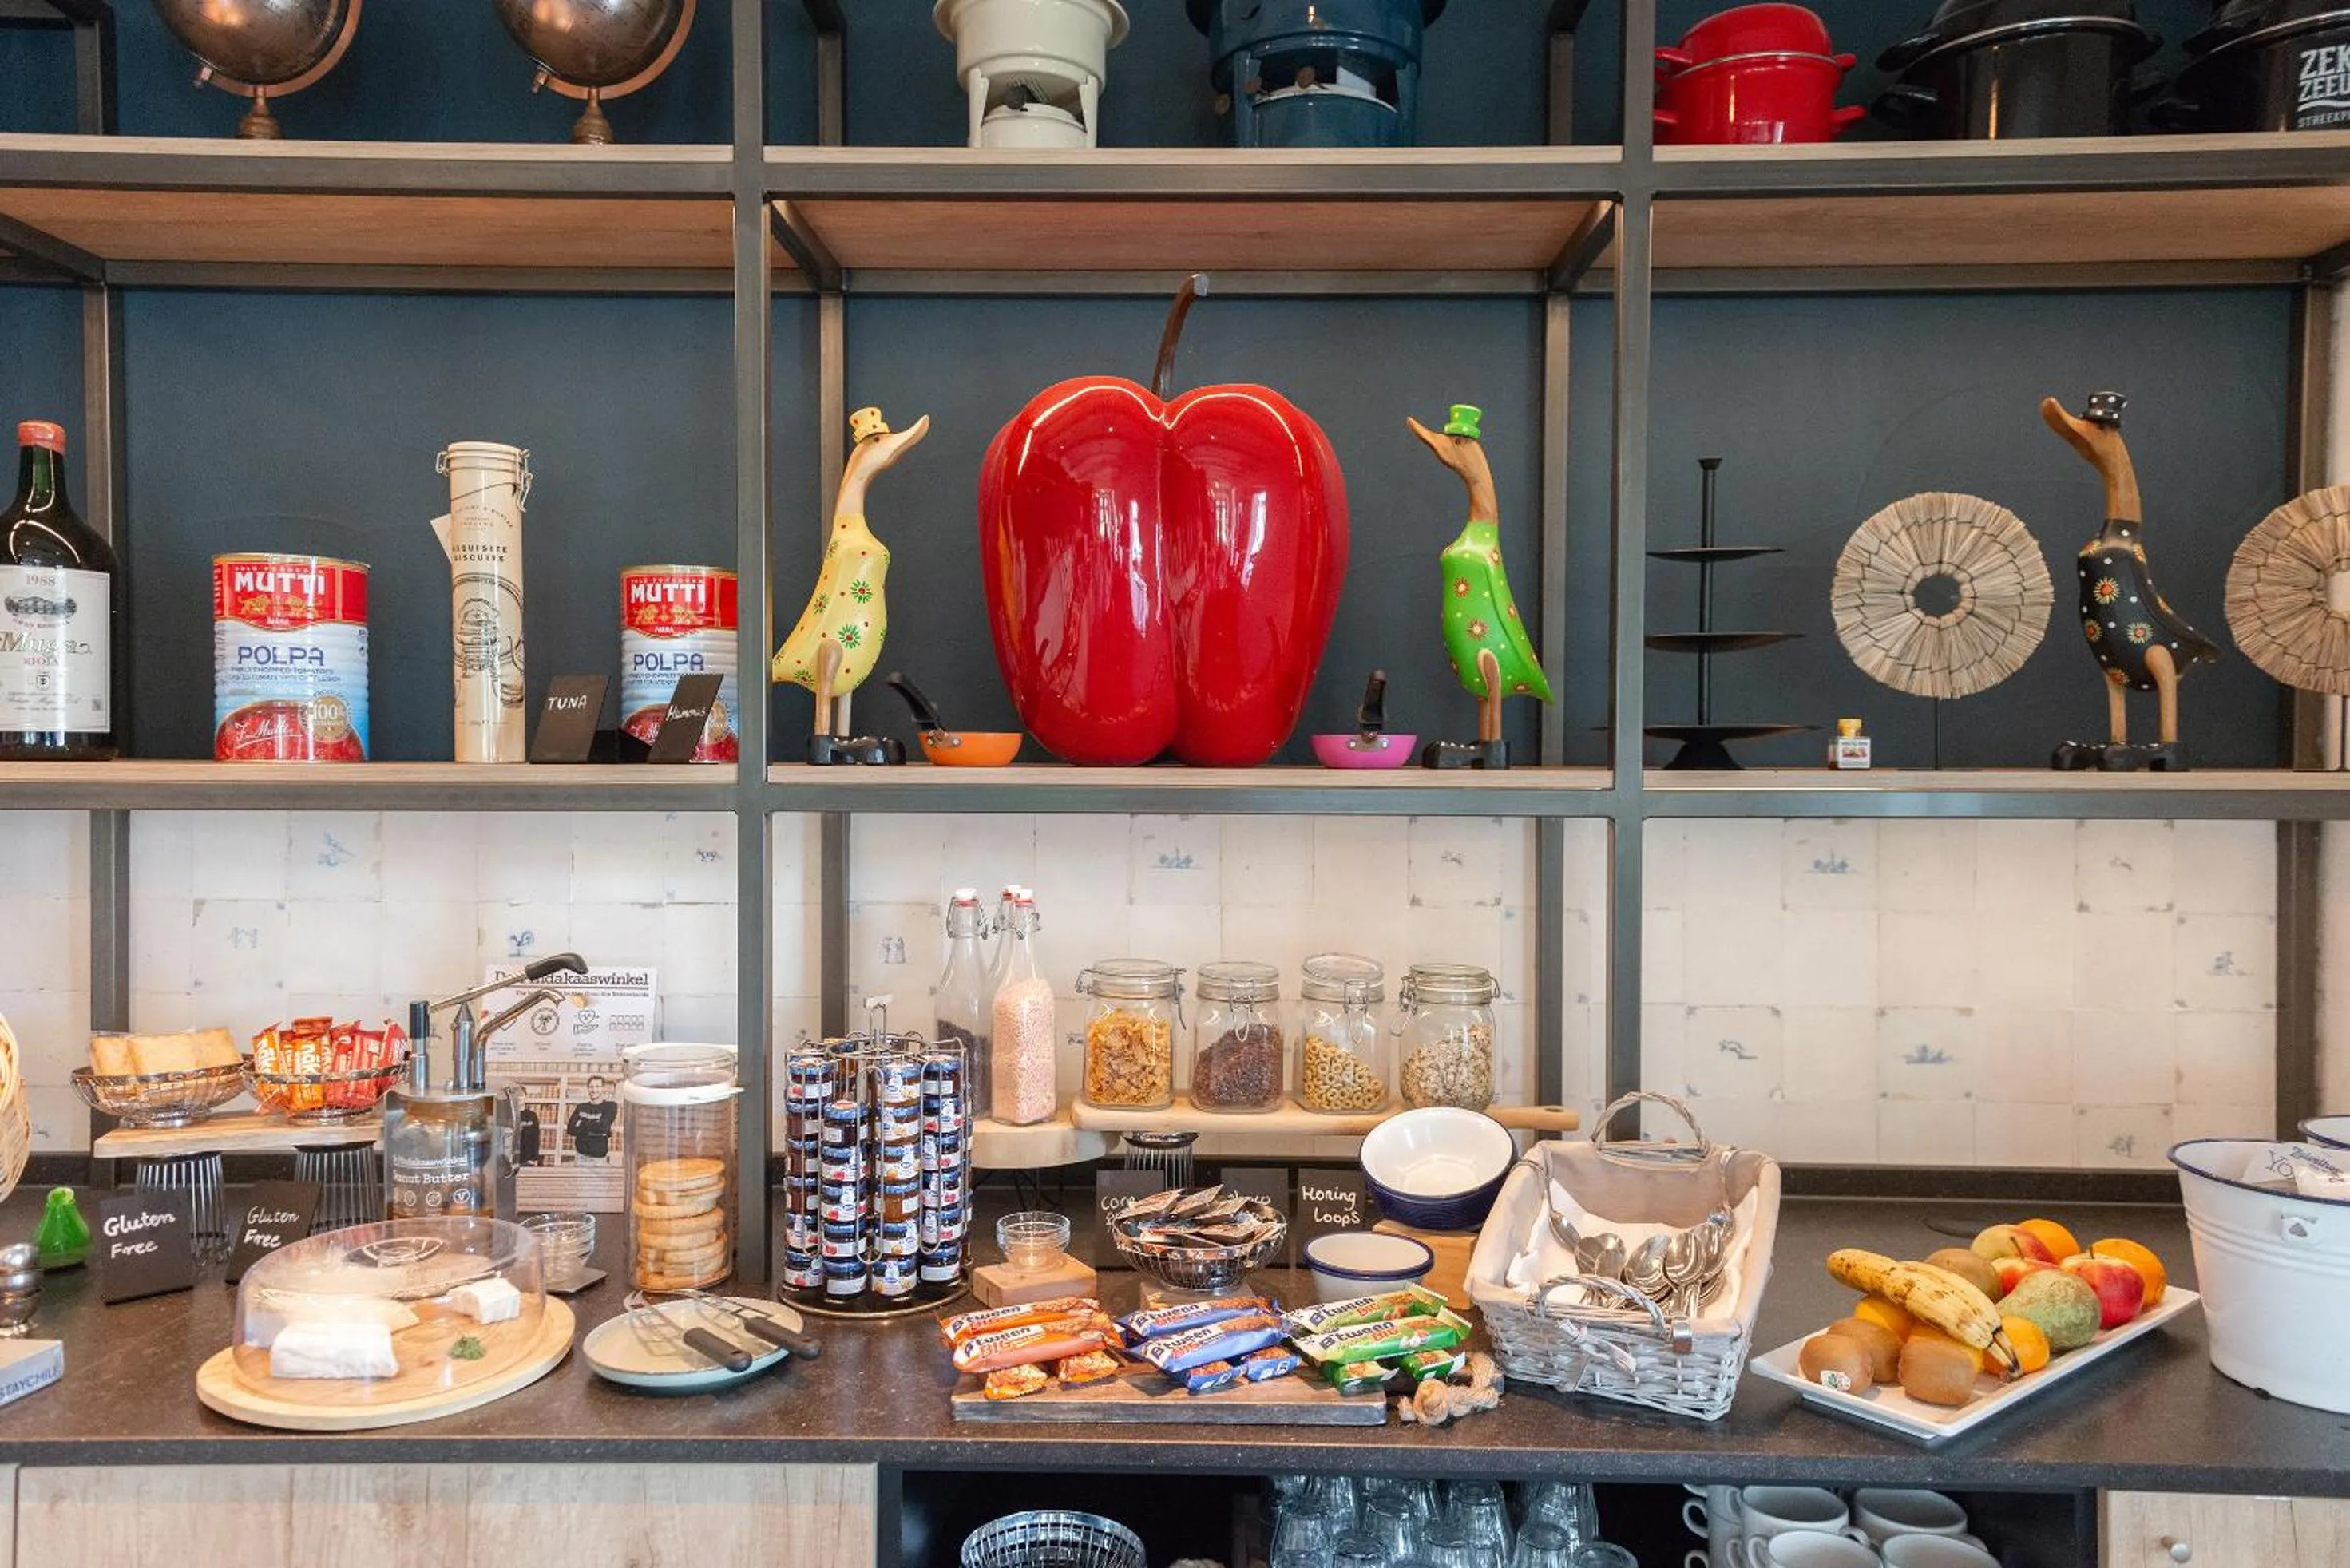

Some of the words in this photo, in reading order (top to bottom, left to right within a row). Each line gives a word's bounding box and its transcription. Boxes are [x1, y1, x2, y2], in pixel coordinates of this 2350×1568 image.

[235, 572, 325, 596] MUTTI
[631, 584, 705, 604] MUTTI
[238, 646, 324, 667] POLPA
[633, 653, 704, 671] POLPA
[548, 695, 588, 711] TUNA
[422, 1172, 470, 1184] Butter
[1302, 1186, 1357, 1212] Honing
[103, 1211, 176, 1237] Gluten
[243, 1229, 282, 1249] Free
[110, 1240, 159, 1260] Free
[1310, 1297, 1374, 1326] B'tween
[1318, 1321, 1394, 1351] B'tween
